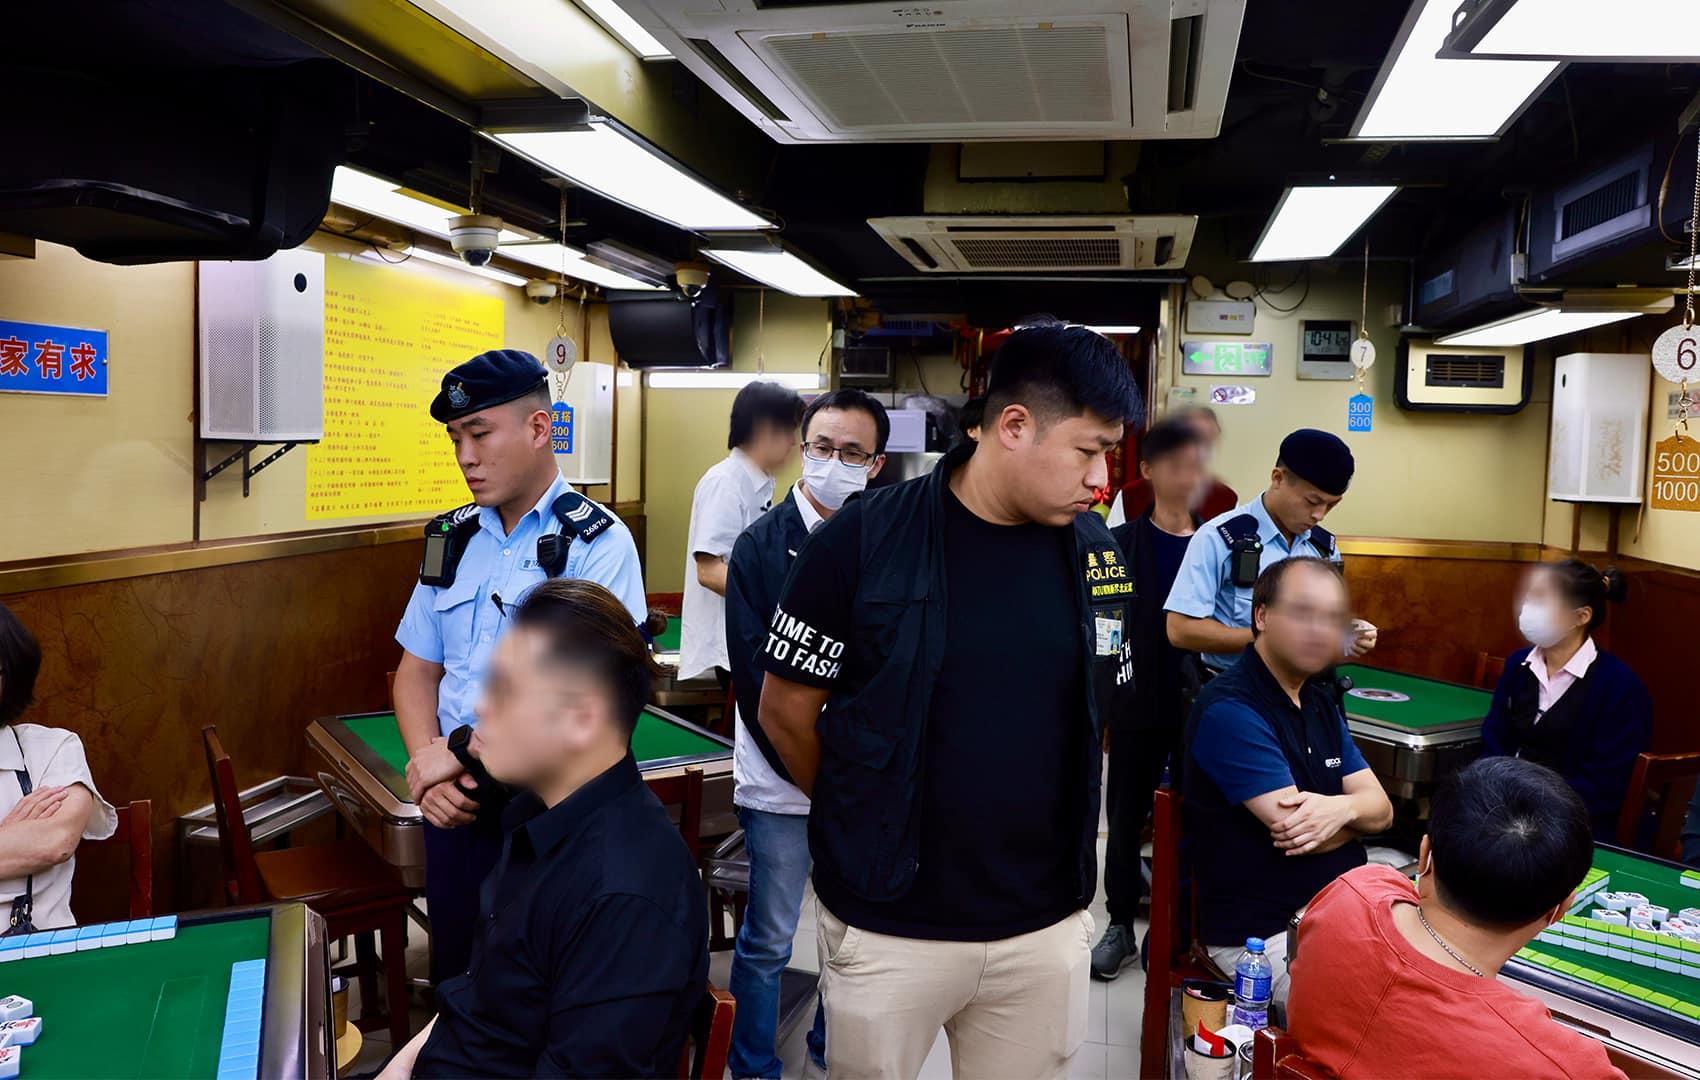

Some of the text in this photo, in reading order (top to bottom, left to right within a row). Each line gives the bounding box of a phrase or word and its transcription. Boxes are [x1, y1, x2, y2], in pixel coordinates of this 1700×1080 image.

[556, 344, 566, 365] 9
[1360, 346, 1368, 362] 7
[1676, 338, 1697, 370] 6
[1350, 402, 1371, 413] 300
[1350, 416, 1371, 427] 600
[552, 426, 569, 437] 300
[1656, 452, 1700, 473] 500
[1654, 481, 1698, 501] 1000
[583, 517, 607, 536] 26876
[1086, 566, 1126, 582] POLICE
[771, 603, 845, 658] TIME TO
[765, 632, 790, 660] TO
